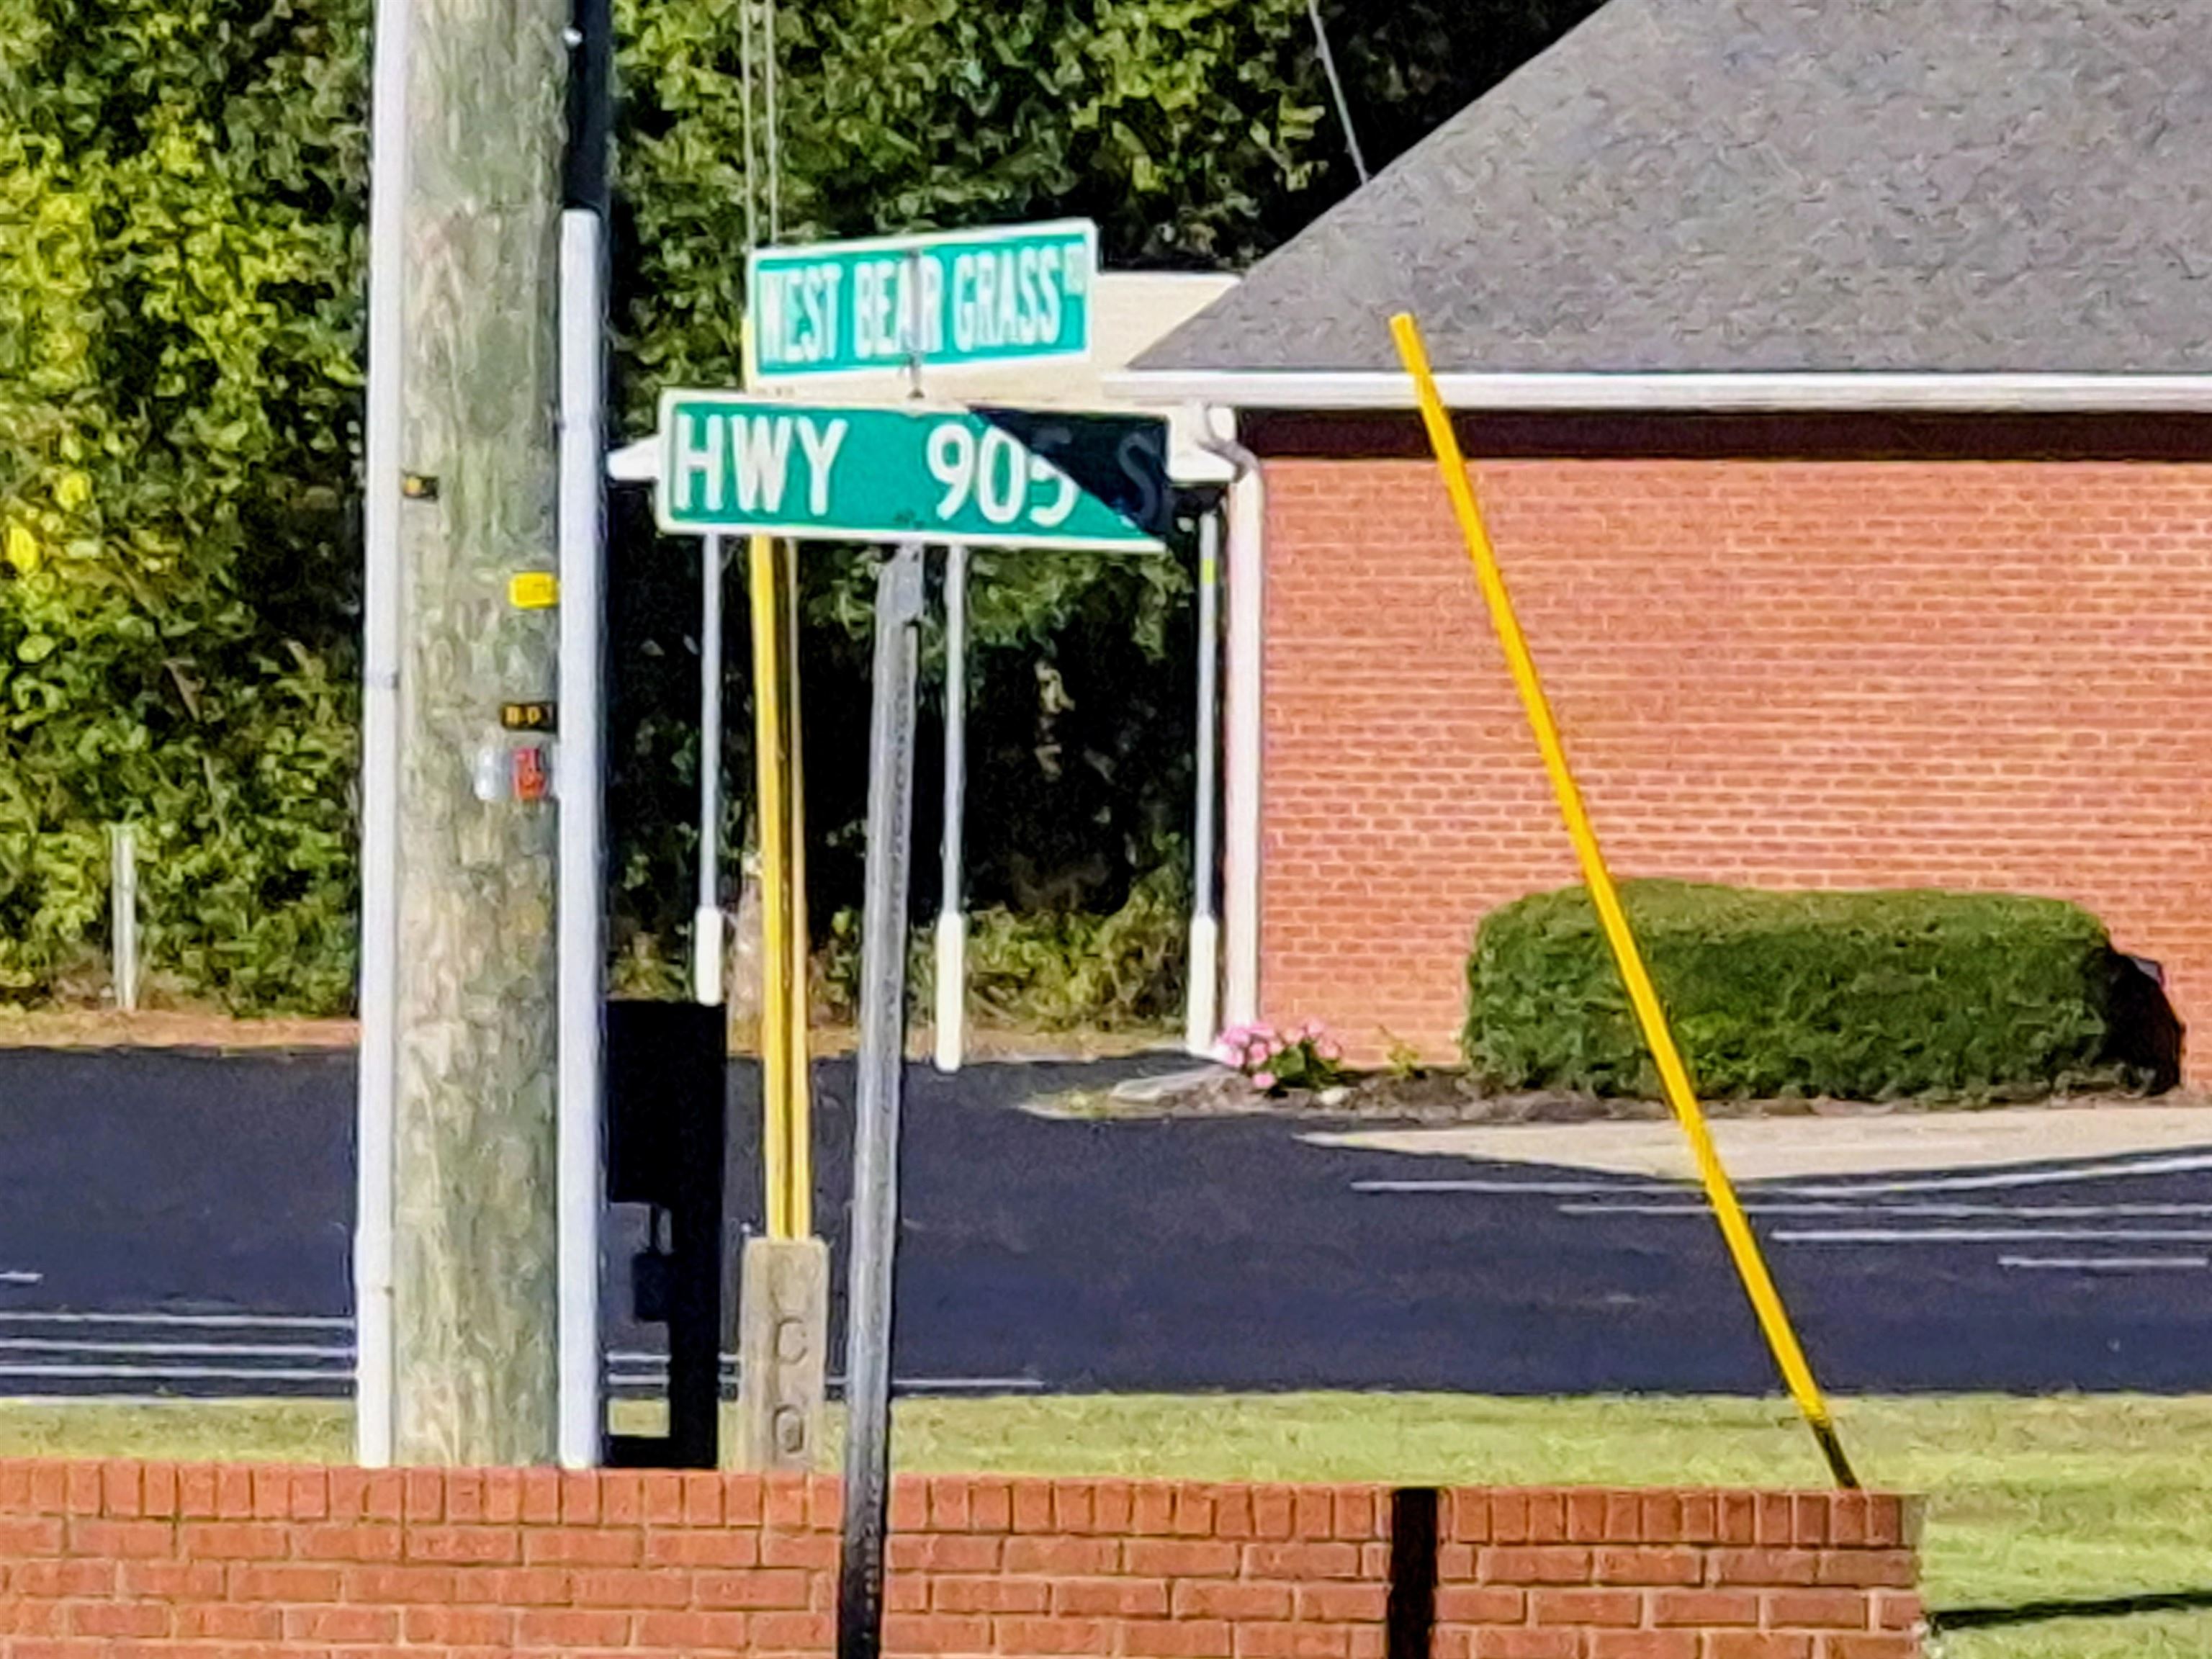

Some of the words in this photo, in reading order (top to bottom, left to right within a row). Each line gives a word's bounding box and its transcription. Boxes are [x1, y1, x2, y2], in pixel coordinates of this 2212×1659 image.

[759, 262, 843, 363] WEST
[854, 255, 944, 359] BEAR
[954, 245, 1062, 352] GRASS
[675, 413, 848, 516] HWY
[927, 423, 1079, 529] 905
